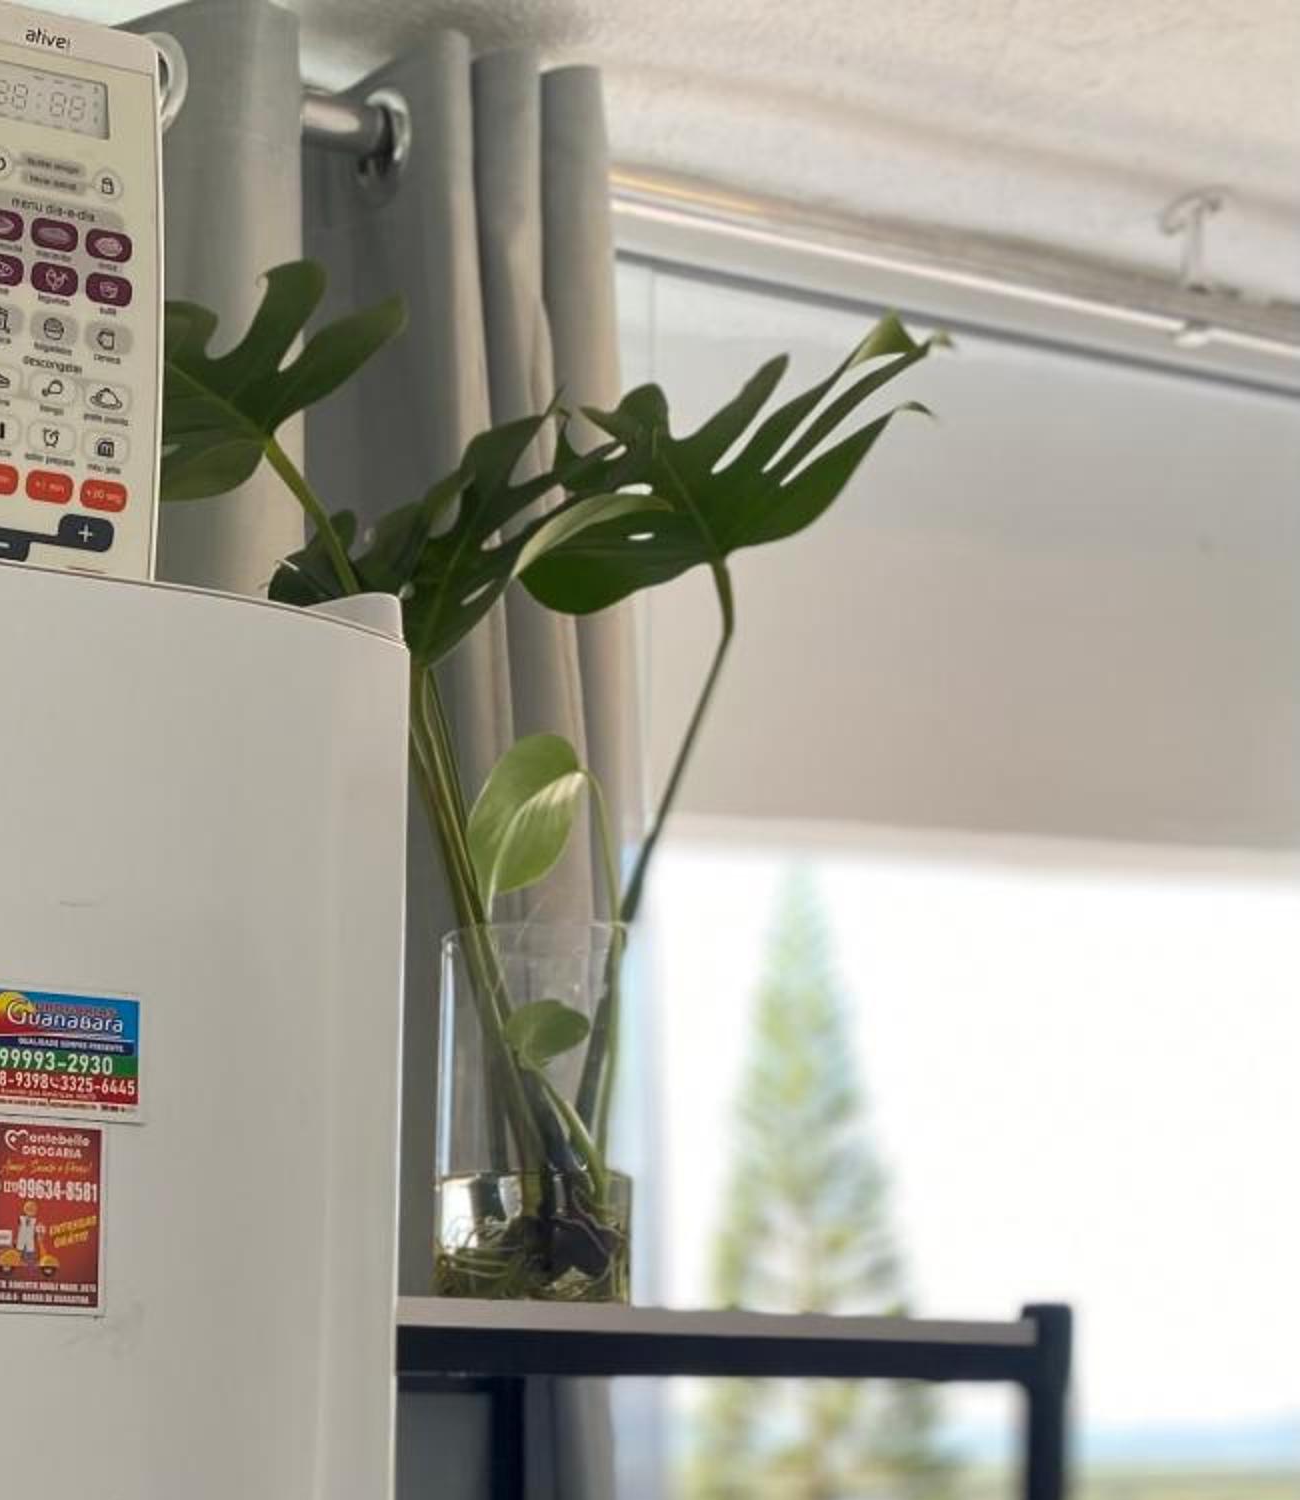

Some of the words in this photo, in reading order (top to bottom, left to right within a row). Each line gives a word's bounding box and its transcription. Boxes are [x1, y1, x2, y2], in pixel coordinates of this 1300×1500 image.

[11, 197, 43, 213] menu
[0, 1048, 113, 1075] 99993-2930
[60, 1075, 136, 1095] 3325-6445
[21, 1145, 82, 1159] DROGARIA
